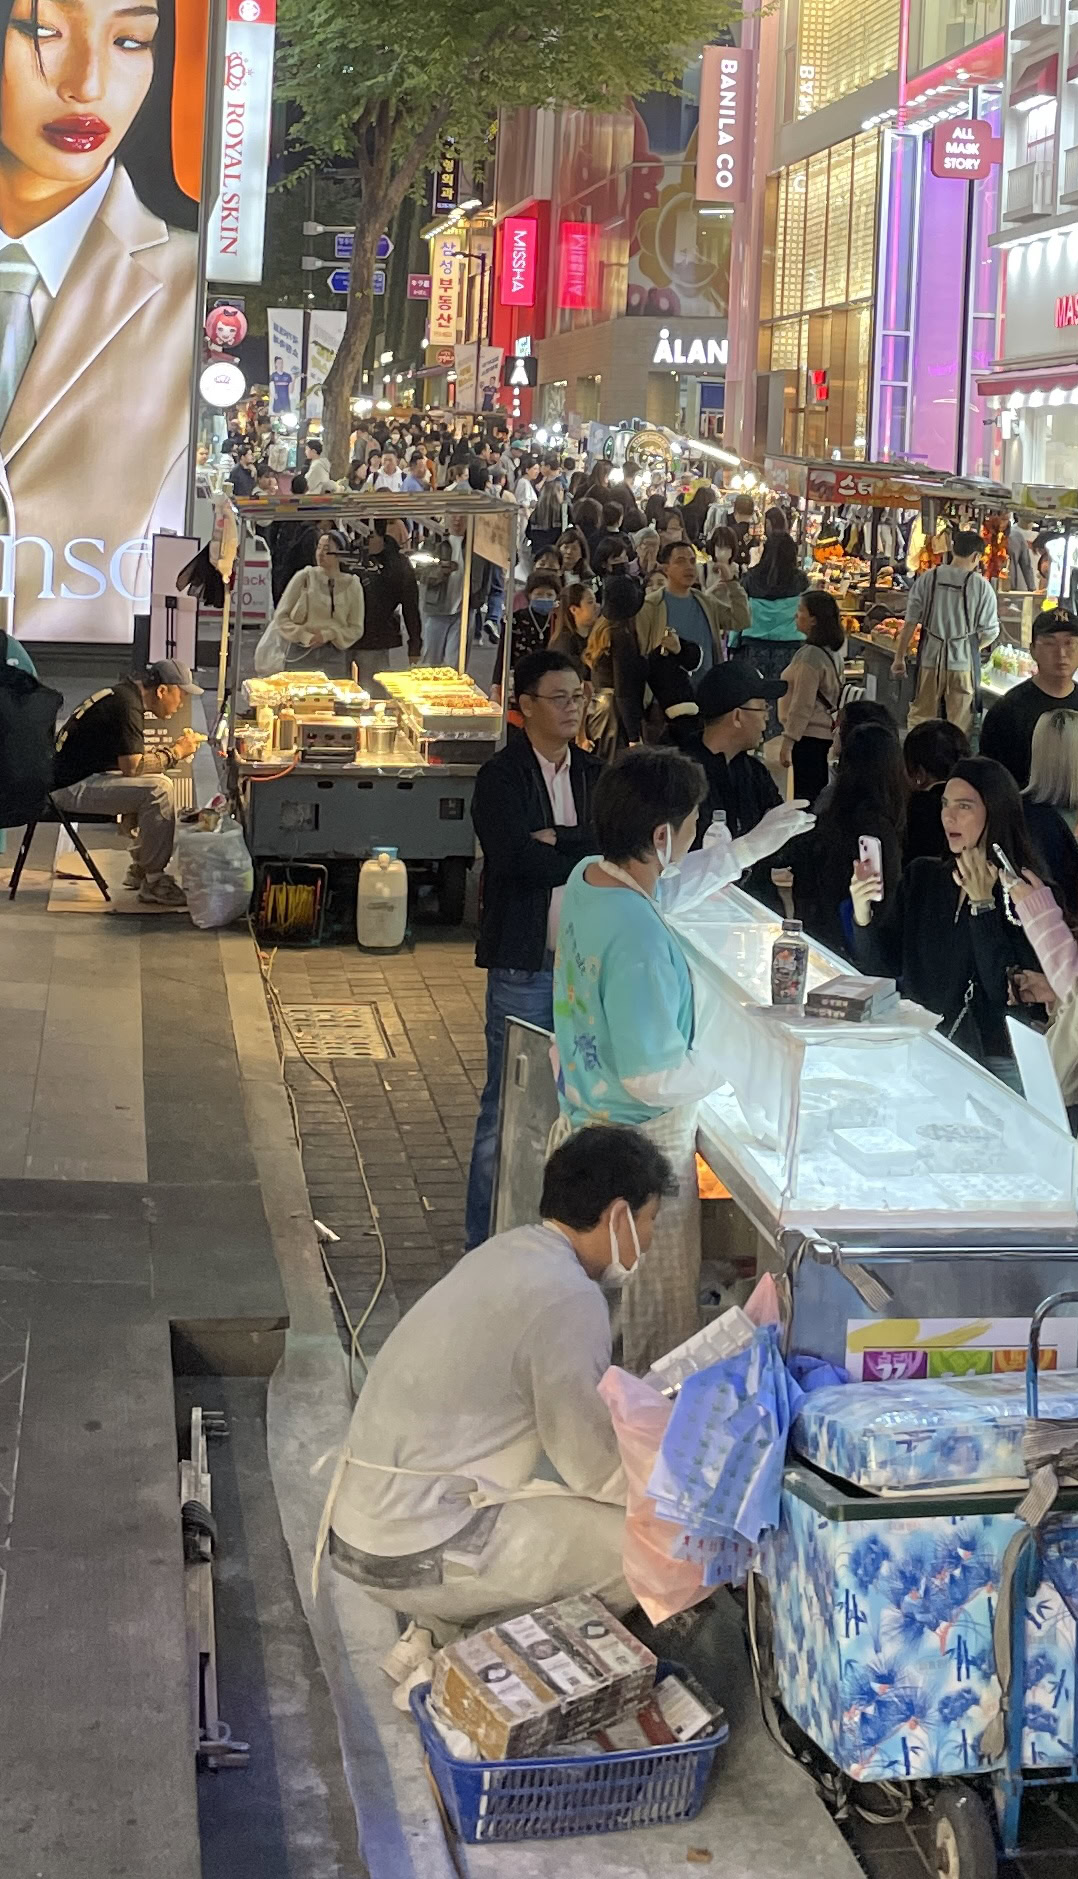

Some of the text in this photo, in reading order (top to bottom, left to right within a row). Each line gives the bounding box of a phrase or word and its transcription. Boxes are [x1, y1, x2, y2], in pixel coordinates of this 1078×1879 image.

[715, 59, 738, 189] BANILA CO
[952, 126, 975, 140] ALL
[944, 157, 981, 170] STORY
[945, 142, 980, 155] MASK
[219, 101, 246, 257] ROYAL SKIN
[441, 153, 455, 201] 형외과
[512, 230, 528, 293] MISSHA
[236, 574, 267, 586] ack
